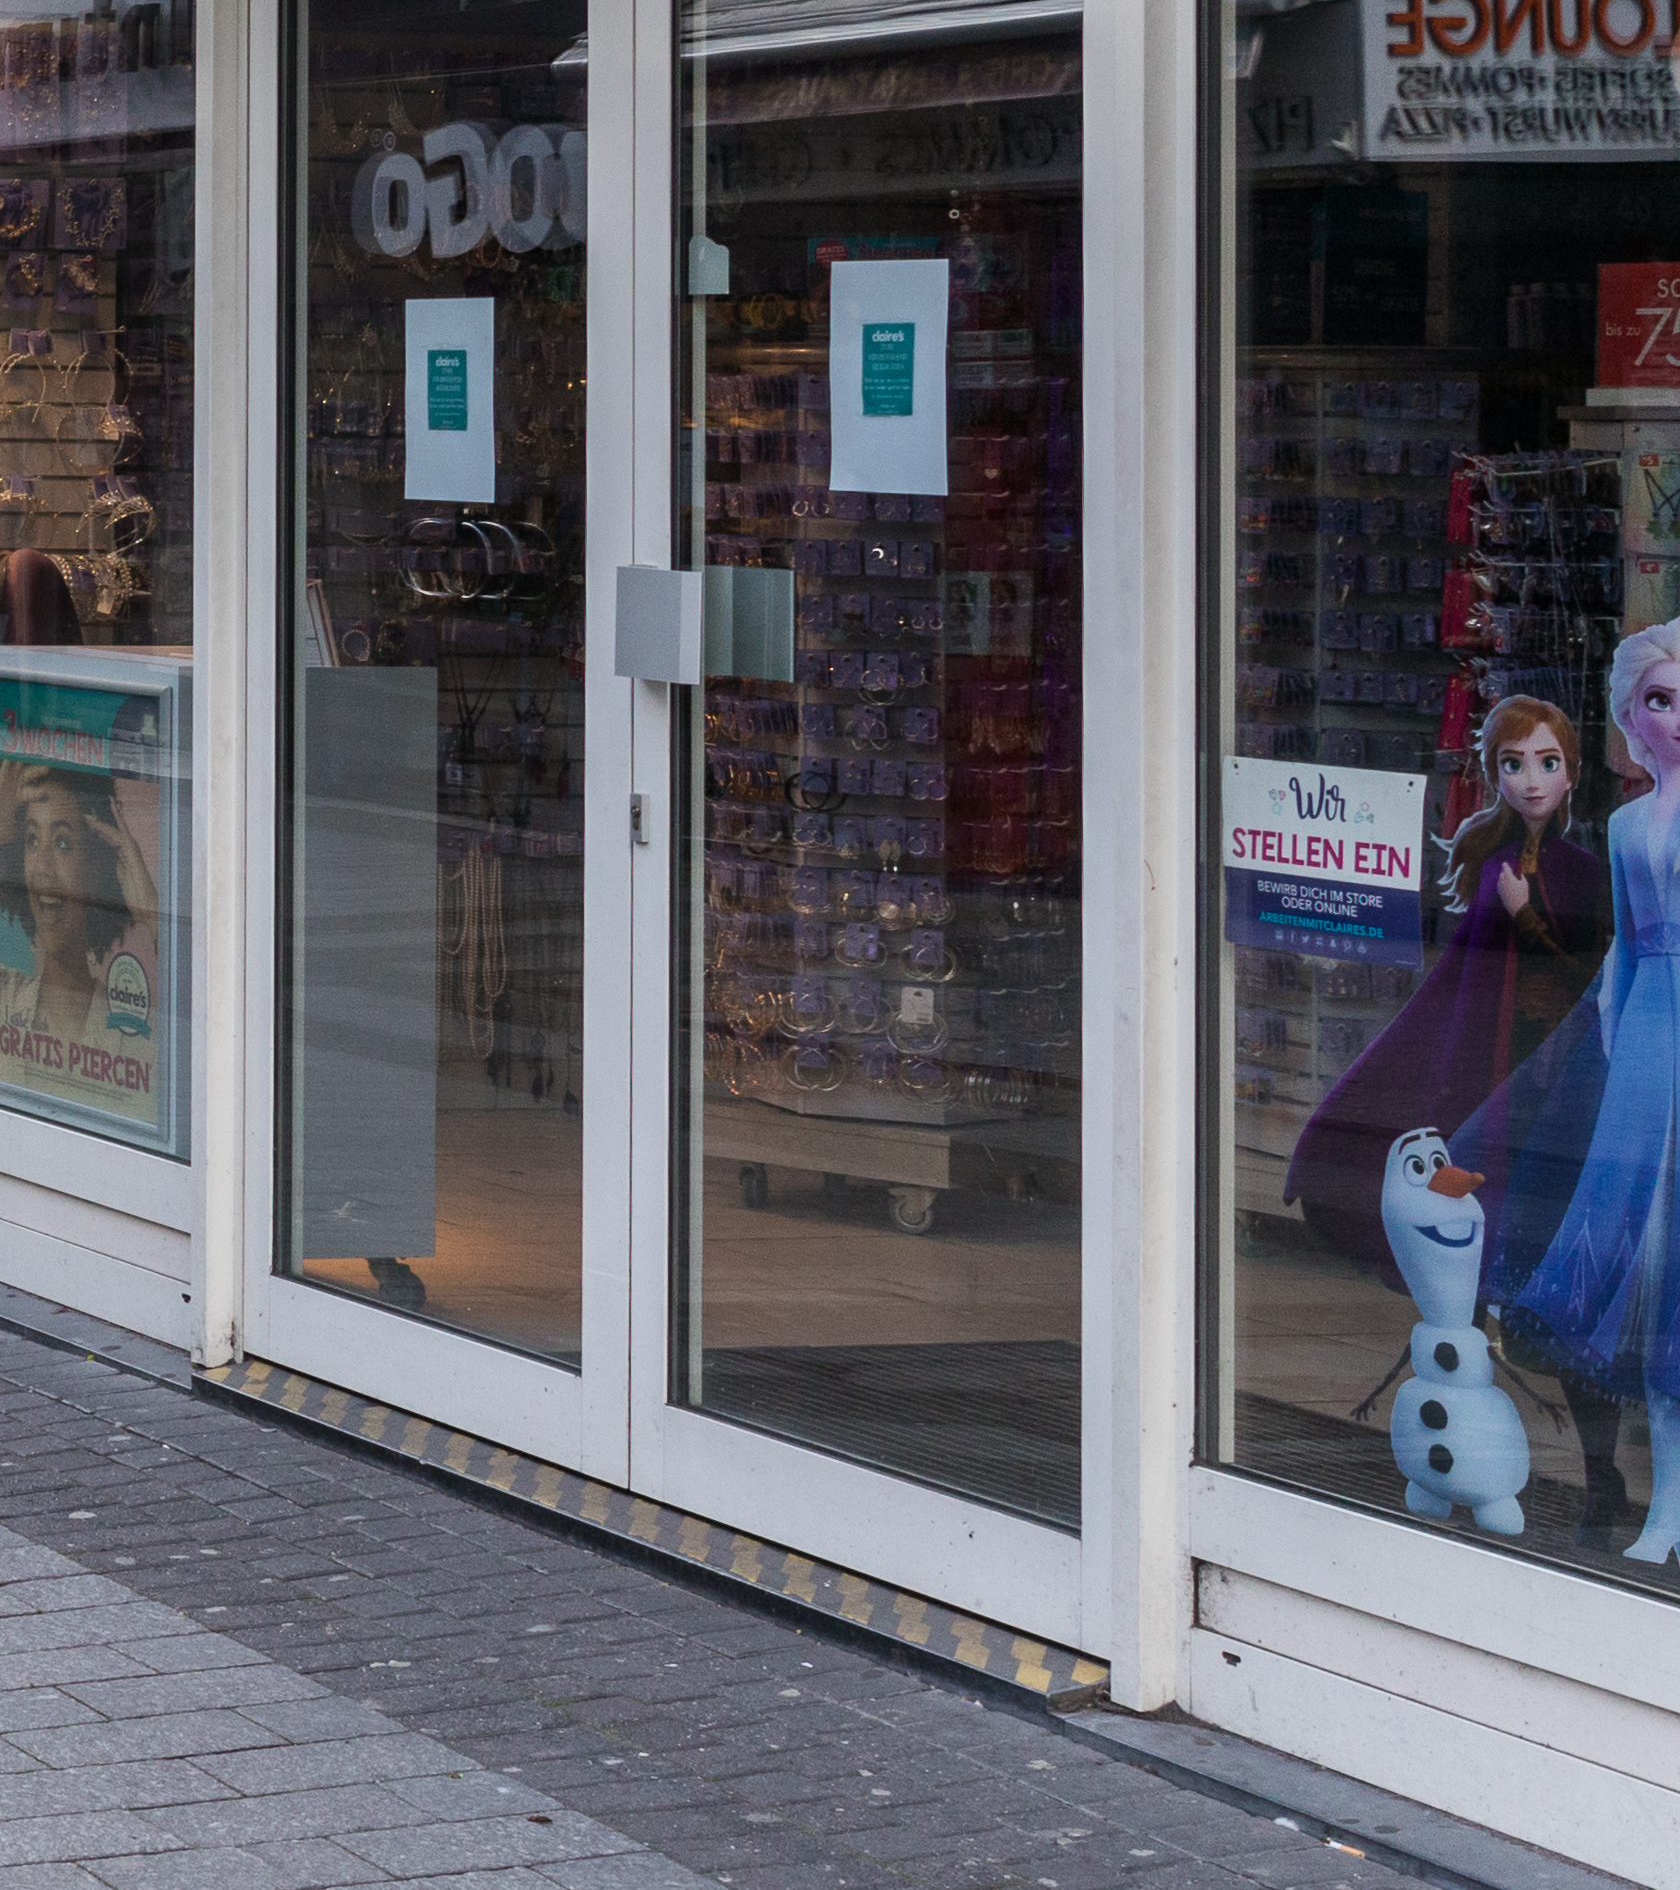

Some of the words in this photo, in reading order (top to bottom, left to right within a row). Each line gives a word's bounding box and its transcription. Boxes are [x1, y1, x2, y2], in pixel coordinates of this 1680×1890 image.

[1605, 321, 1622, 336] bis
[1626, 326, 1640, 336] zu
[3, 708, 19, 754] 3
[19, 723, 104, 766] WOCHEN
[1288, 772, 1347, 823] Wir
[1232, 826, 1345, 870] STELLEN
[1354, 841, 1410, 879] EIN
[1257, 879, 1298, 897] BEWIRB
[1300, 886, 1328, 900] DICH
[1330, 890, 1343, 902] IM
[1346, 892, 1383, 908] STORE
[1281, 896, 1313, 911] ODER
[1314, 901, 1358, 918] ONLINE
[1259, 911, 1384, 939] ARBEITENMITCLAIRES.DE
[108, 981, 148, 1010] claire's
[68, 1041, 152, 1095] PIERCEN
